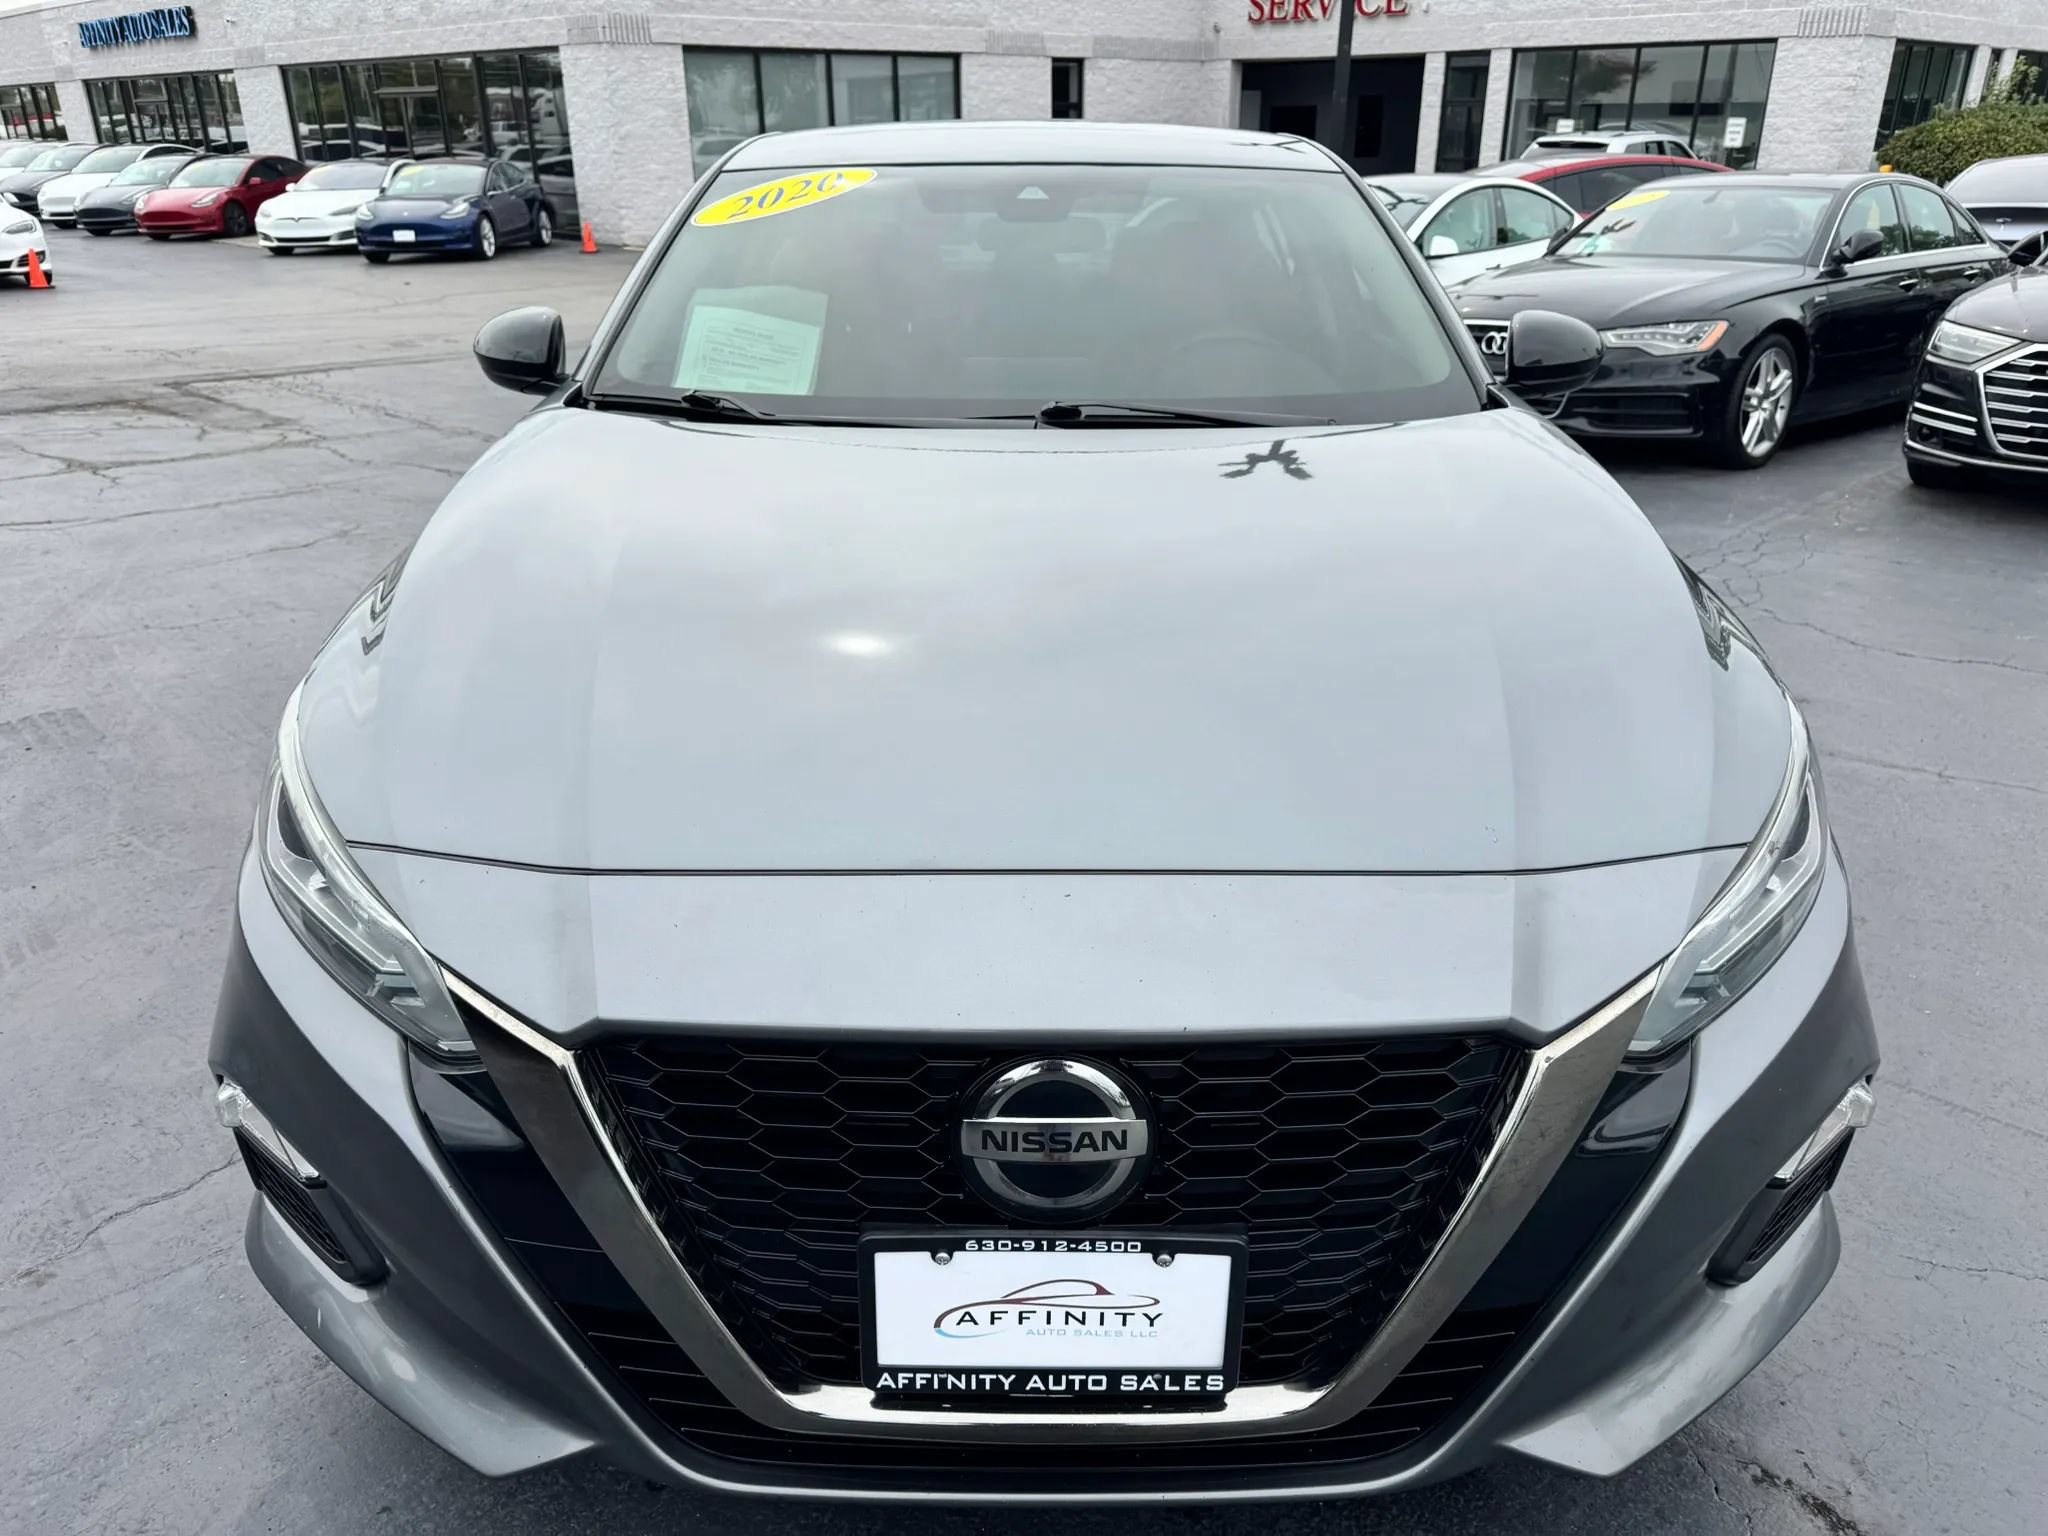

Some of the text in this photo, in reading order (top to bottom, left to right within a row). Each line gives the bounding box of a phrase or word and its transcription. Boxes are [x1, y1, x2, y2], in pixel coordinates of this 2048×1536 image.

[1248, 0, 1409, 24] SERVCE
[122, 11, 152, 43] AUTO
[149, 6, 190, 39] SALES
[726, 172, 844, 220] 2020
[981, 1129, 1128, 1153] NISSAN
[965, 1240, 1142, 1252] 630-912-4500
[956, 1310, 1163, 1327] AFFINITY
[1026, 1328, 1158, 1338] AUTO SALES LLC
[876, 1372, 1224, 1391] AFFINITY AUTO SALES
